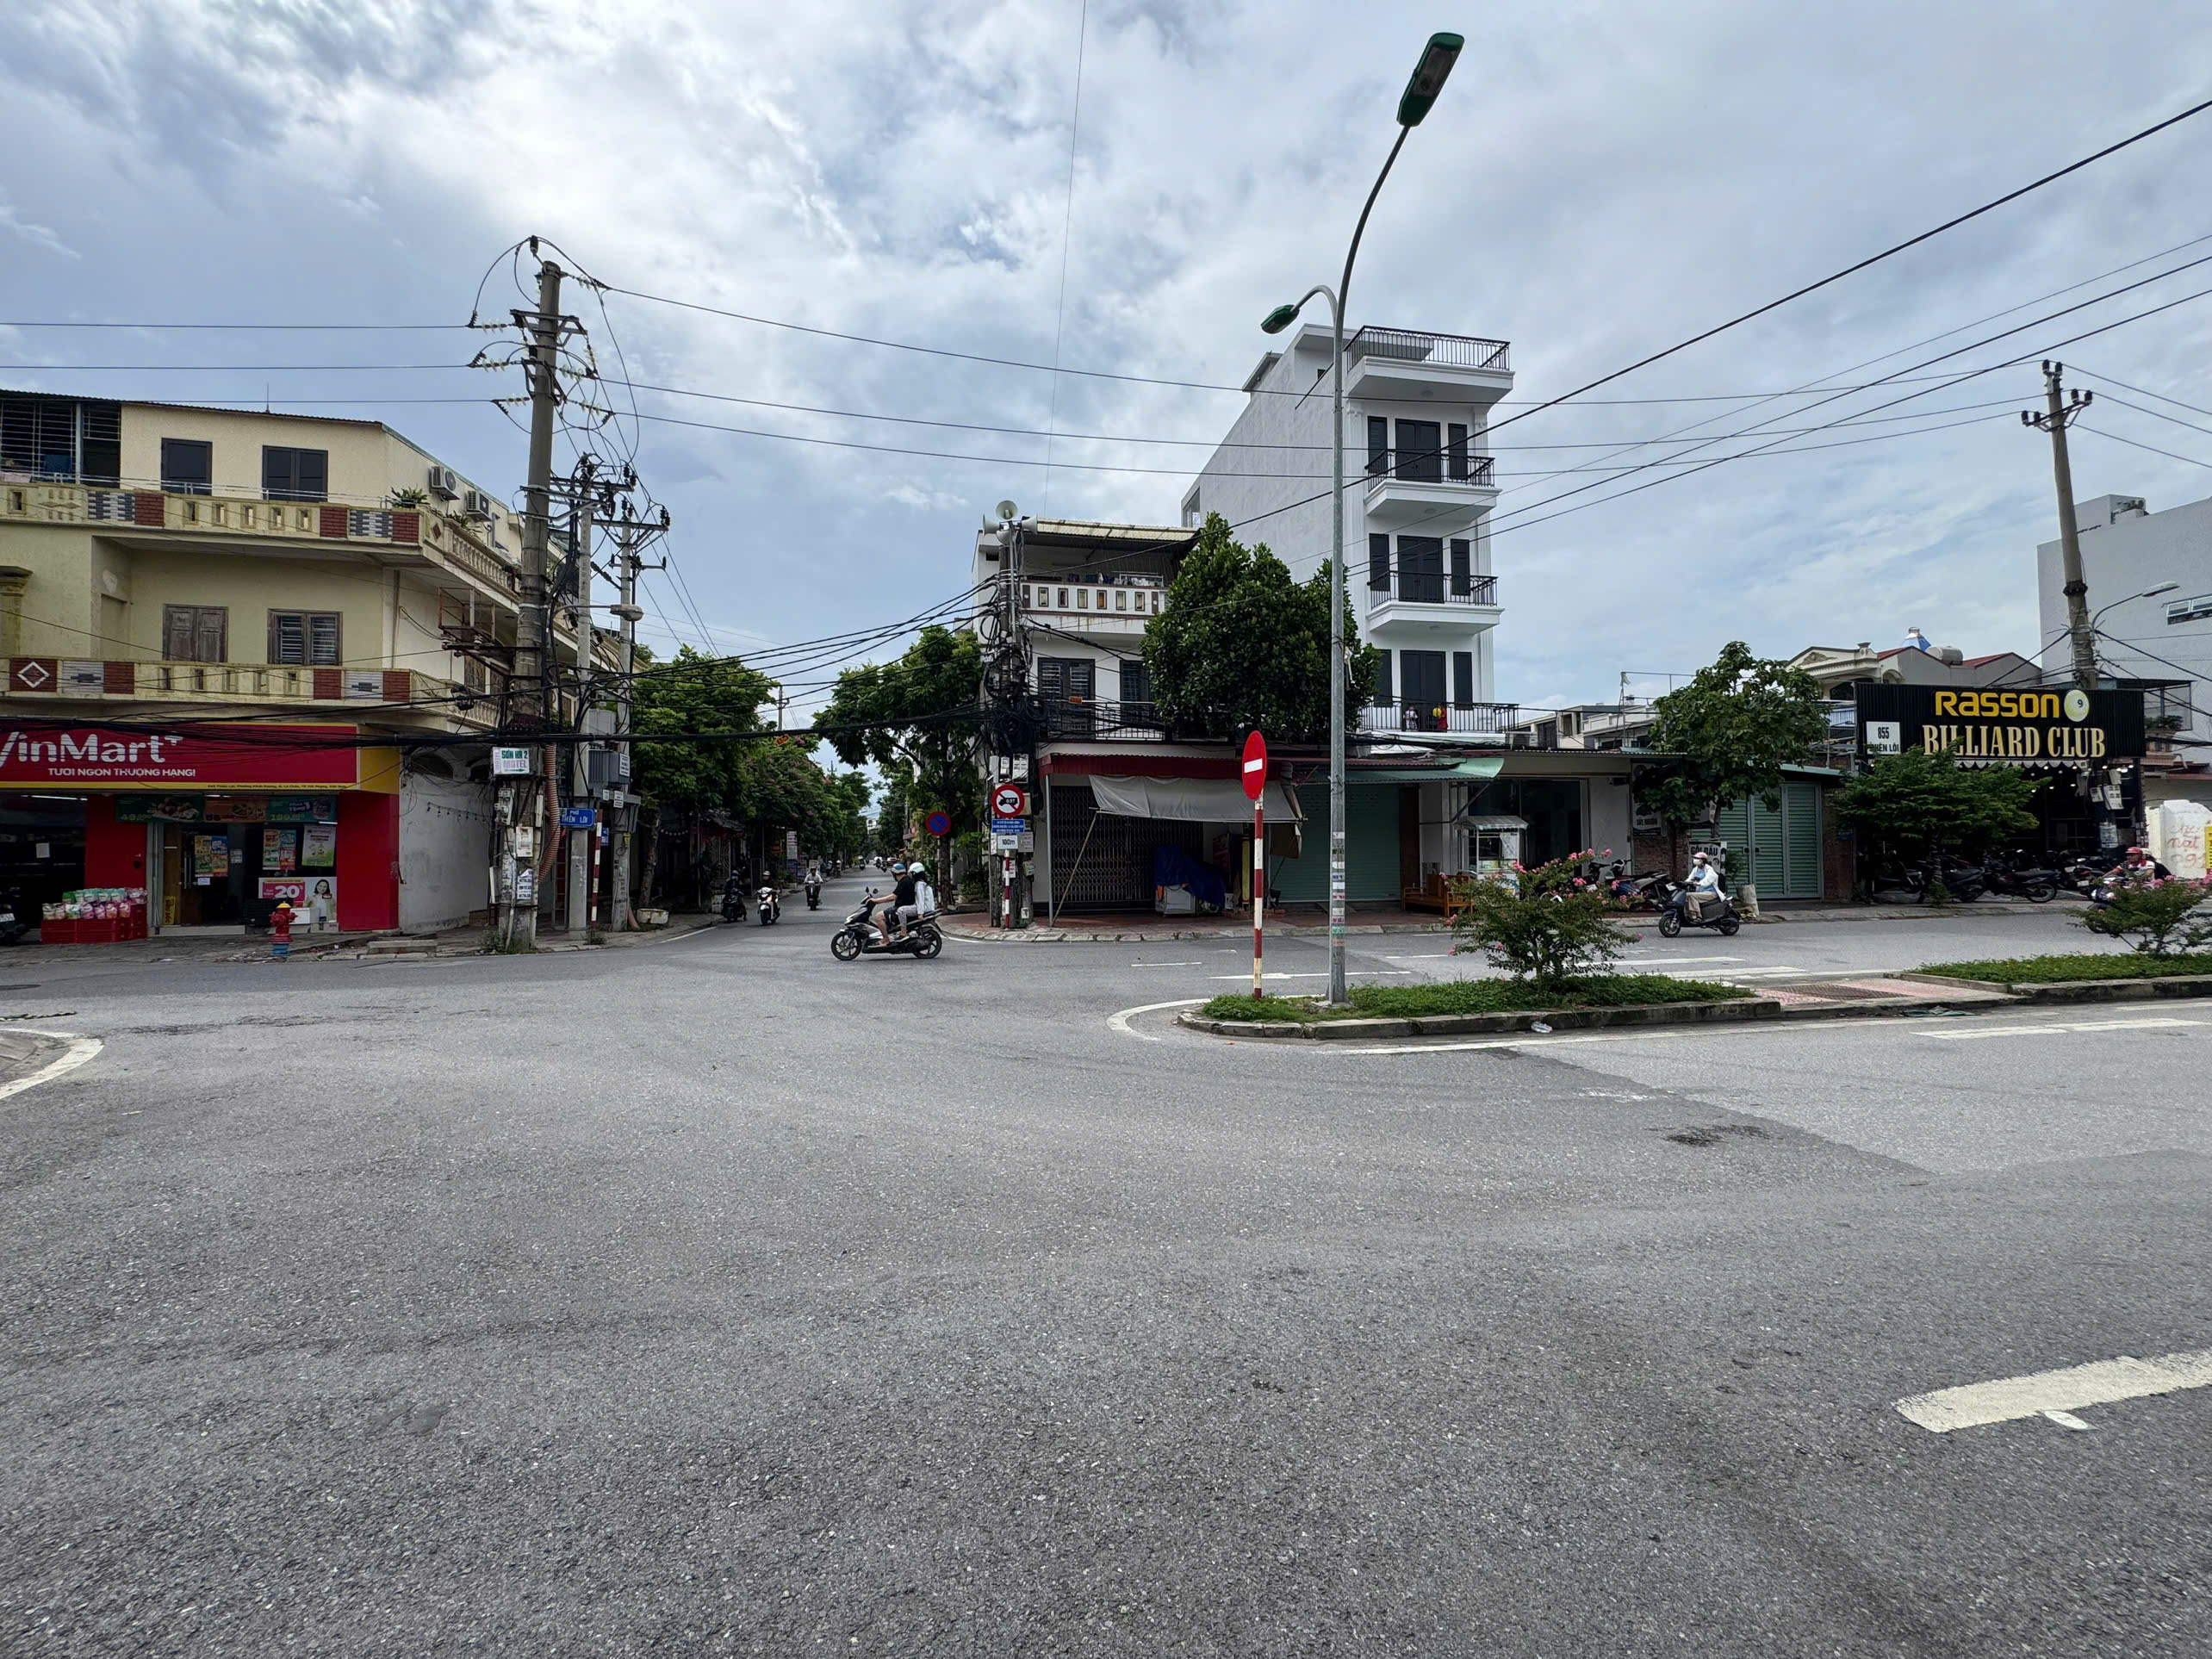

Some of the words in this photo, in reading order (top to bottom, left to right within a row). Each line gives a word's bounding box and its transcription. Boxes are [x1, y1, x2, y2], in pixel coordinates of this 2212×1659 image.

[2077, 699, 2084, 708] 9
[1877, 726, 1890, 739] 855
[1922, 724, 2041, 757] BILLIARD
[2047, 726, 2106, 758] CLUB
[524, 750, 528, 759] 2
[78, 767, 111, 776] NGON
